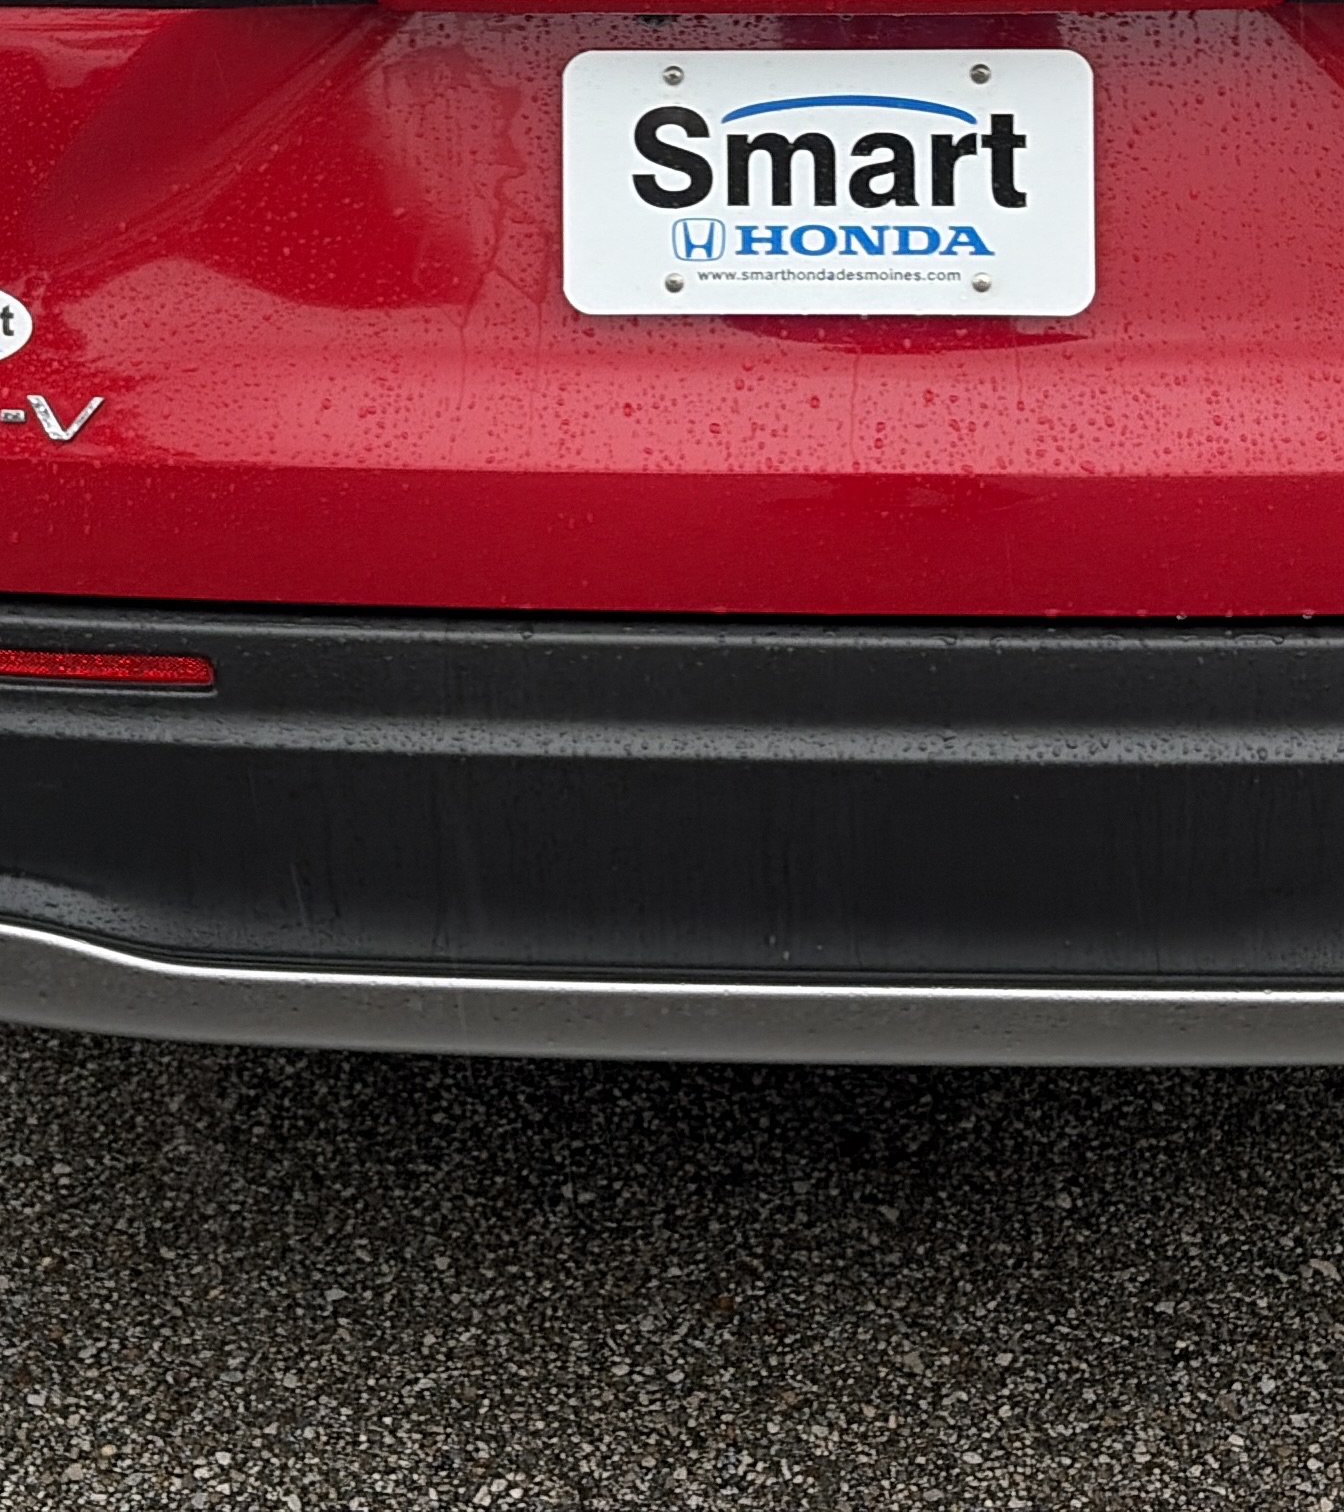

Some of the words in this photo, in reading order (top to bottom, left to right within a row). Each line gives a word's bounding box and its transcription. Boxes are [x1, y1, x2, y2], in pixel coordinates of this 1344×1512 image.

[632, 106, 1027, 209] Smart
[735, 225, 995, 256] HONDA
[697, 268, 961, 281] www.smarthondadesmoines.com
